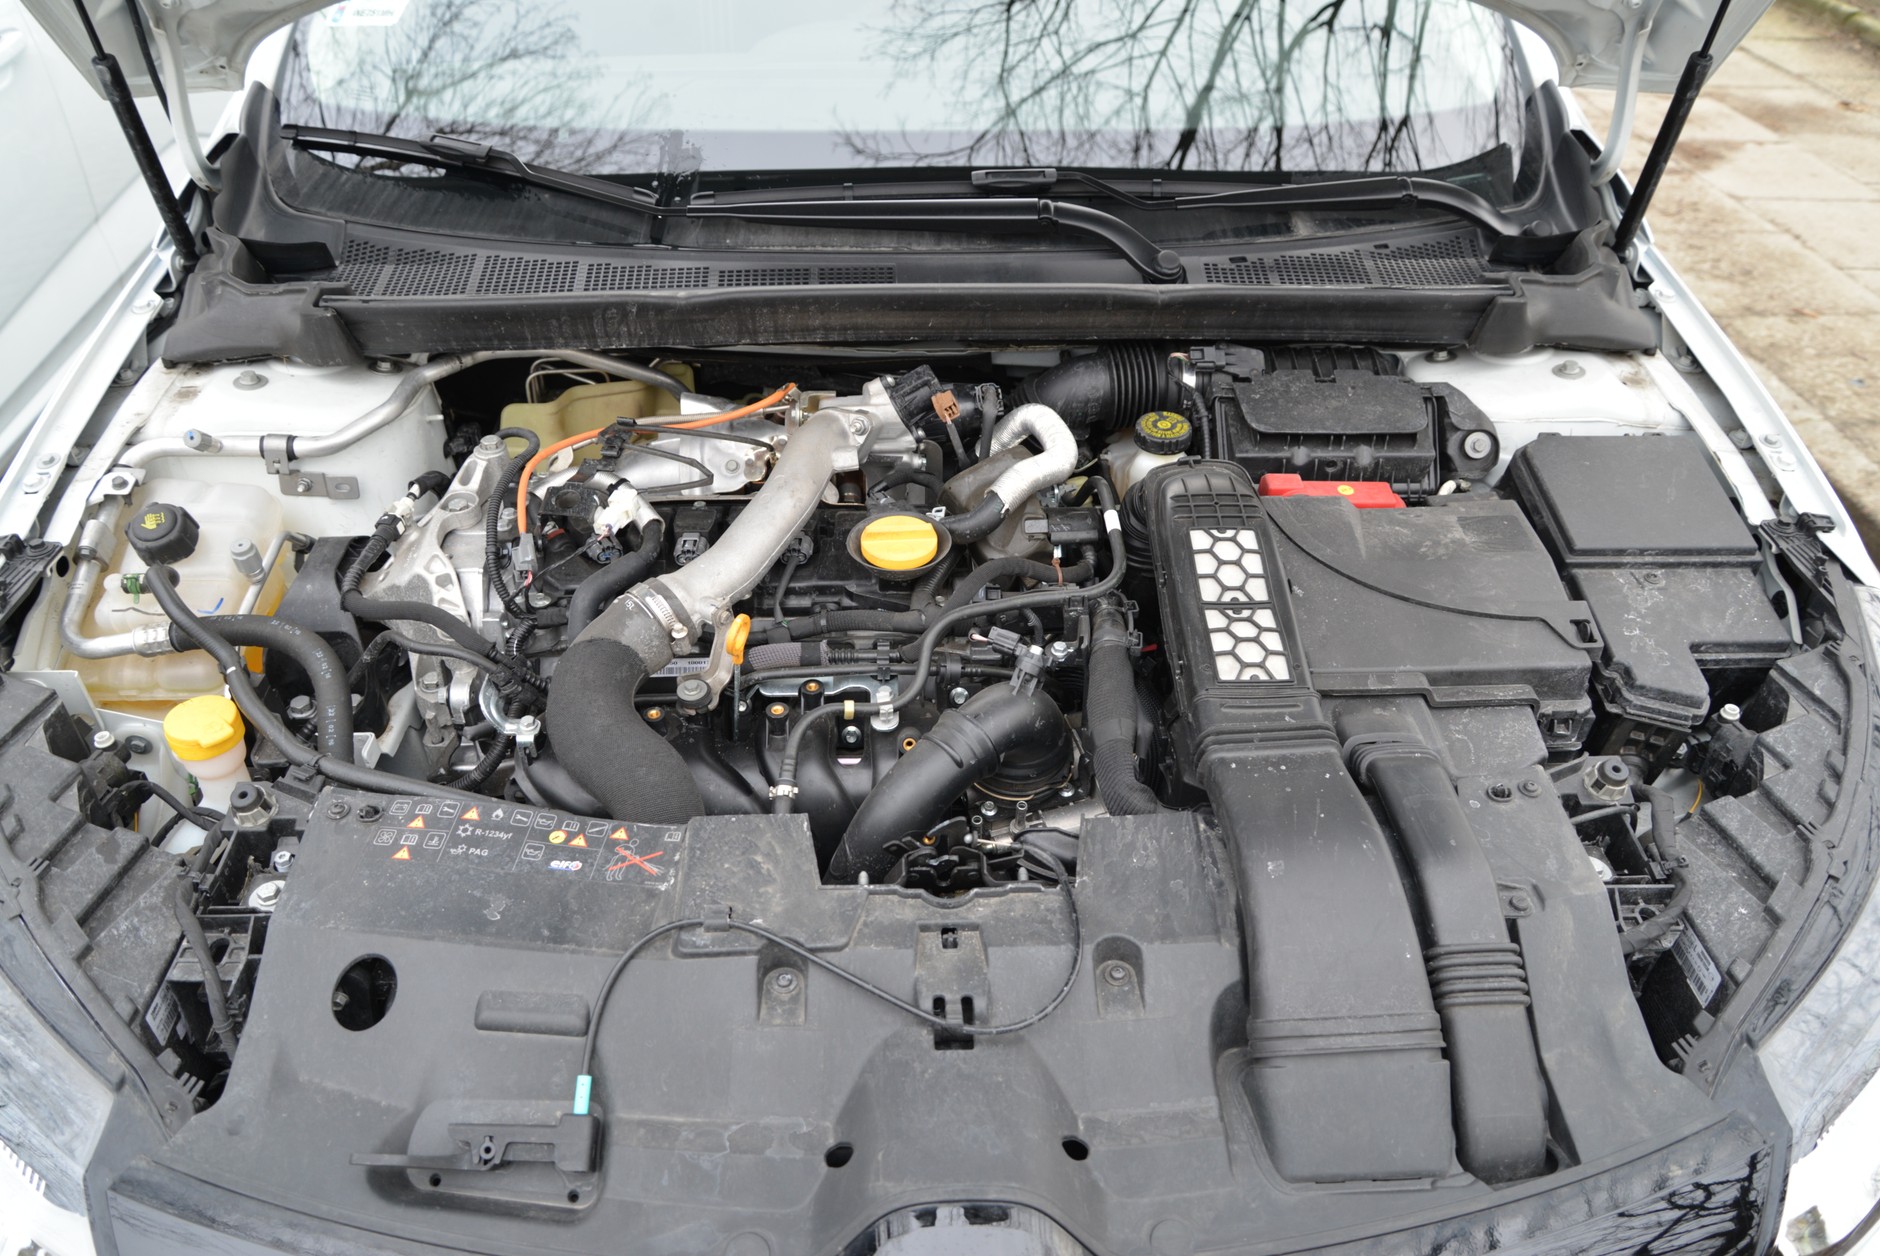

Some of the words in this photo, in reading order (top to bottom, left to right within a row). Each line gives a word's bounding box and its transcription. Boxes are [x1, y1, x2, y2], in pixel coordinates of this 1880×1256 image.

[475, 829, 513, 840] R-1234yf
[468, 847, 489, 856] PAG
[549, 860, 572, 870] elf
